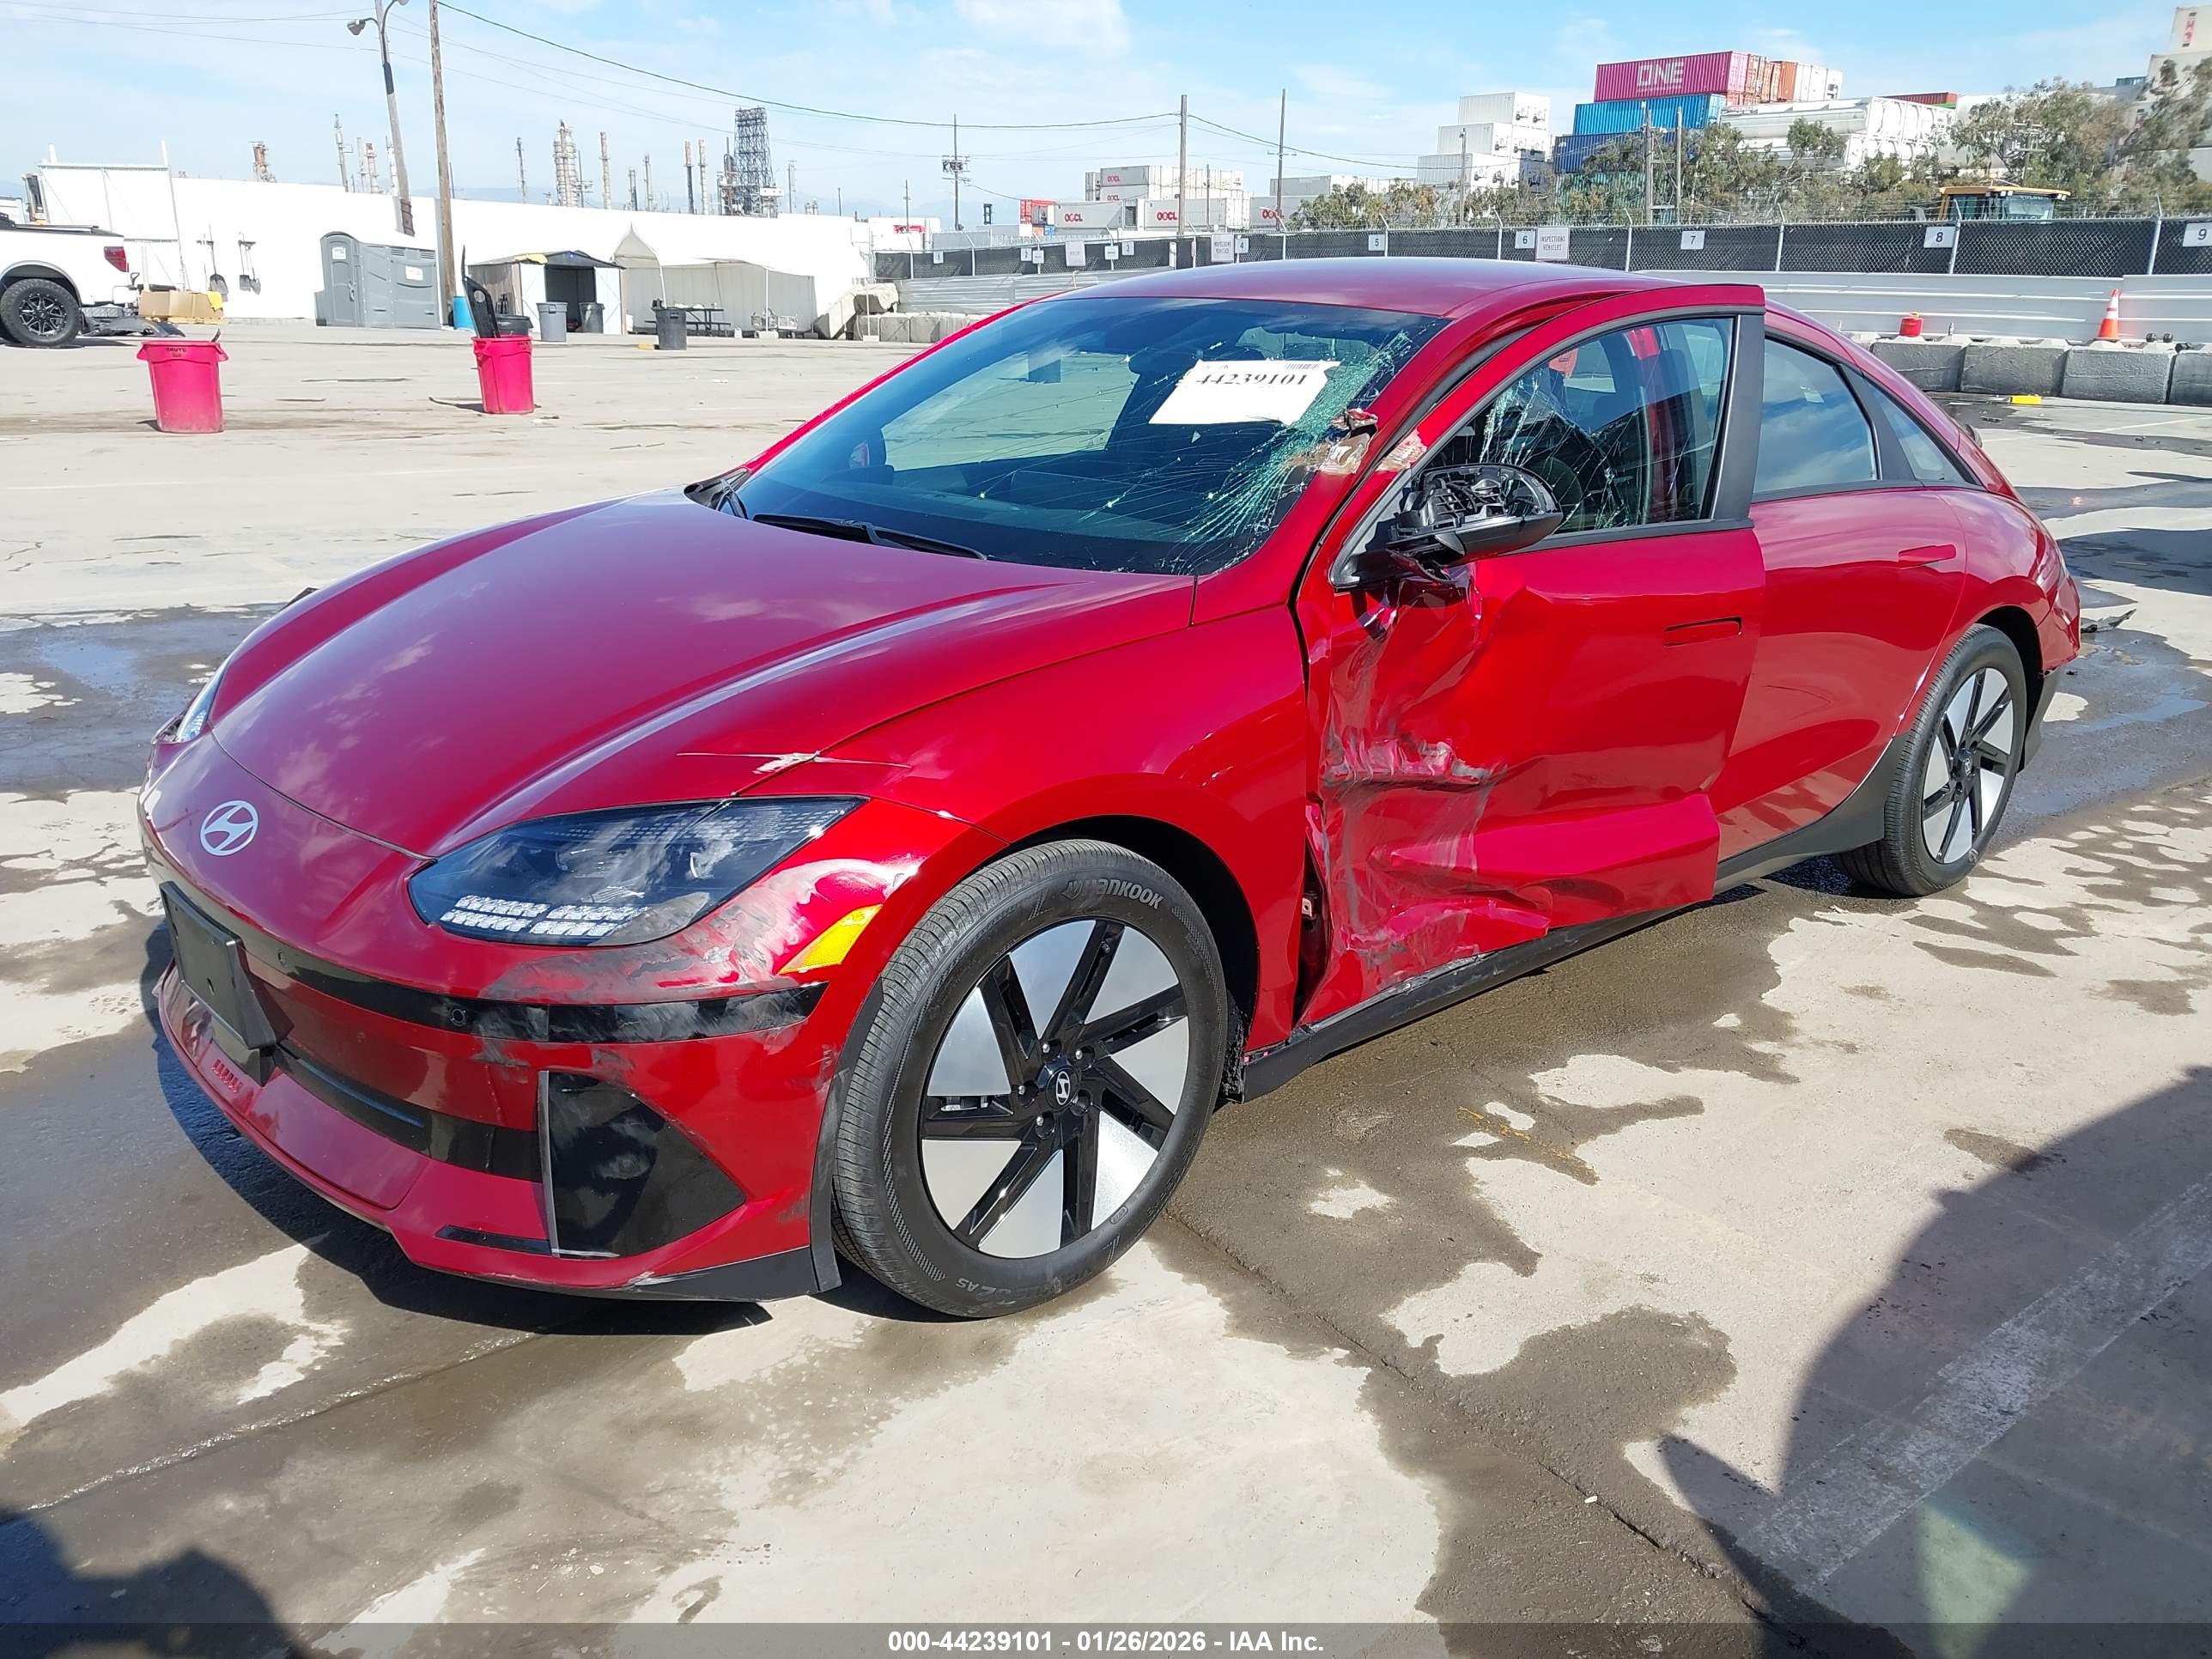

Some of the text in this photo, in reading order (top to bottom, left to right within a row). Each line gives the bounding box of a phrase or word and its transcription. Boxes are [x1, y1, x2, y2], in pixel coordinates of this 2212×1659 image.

[1638, 62, 1684, 87] ONE
[1064, 213, 1083, 222] OOCL
[1157, 211, 1177, 221] OOCL
[1936, 232, 1944, 243] 8
[2198, 228, 2207, 240] 9
[1374, 239, 1380, 247] 5
[1522, 235, 1528, 245] 6
[1690, 235, 1697, 245] 7
[1239, 241, 1244, 250] 4
[1195, 374, 1309, 386] 44239101
